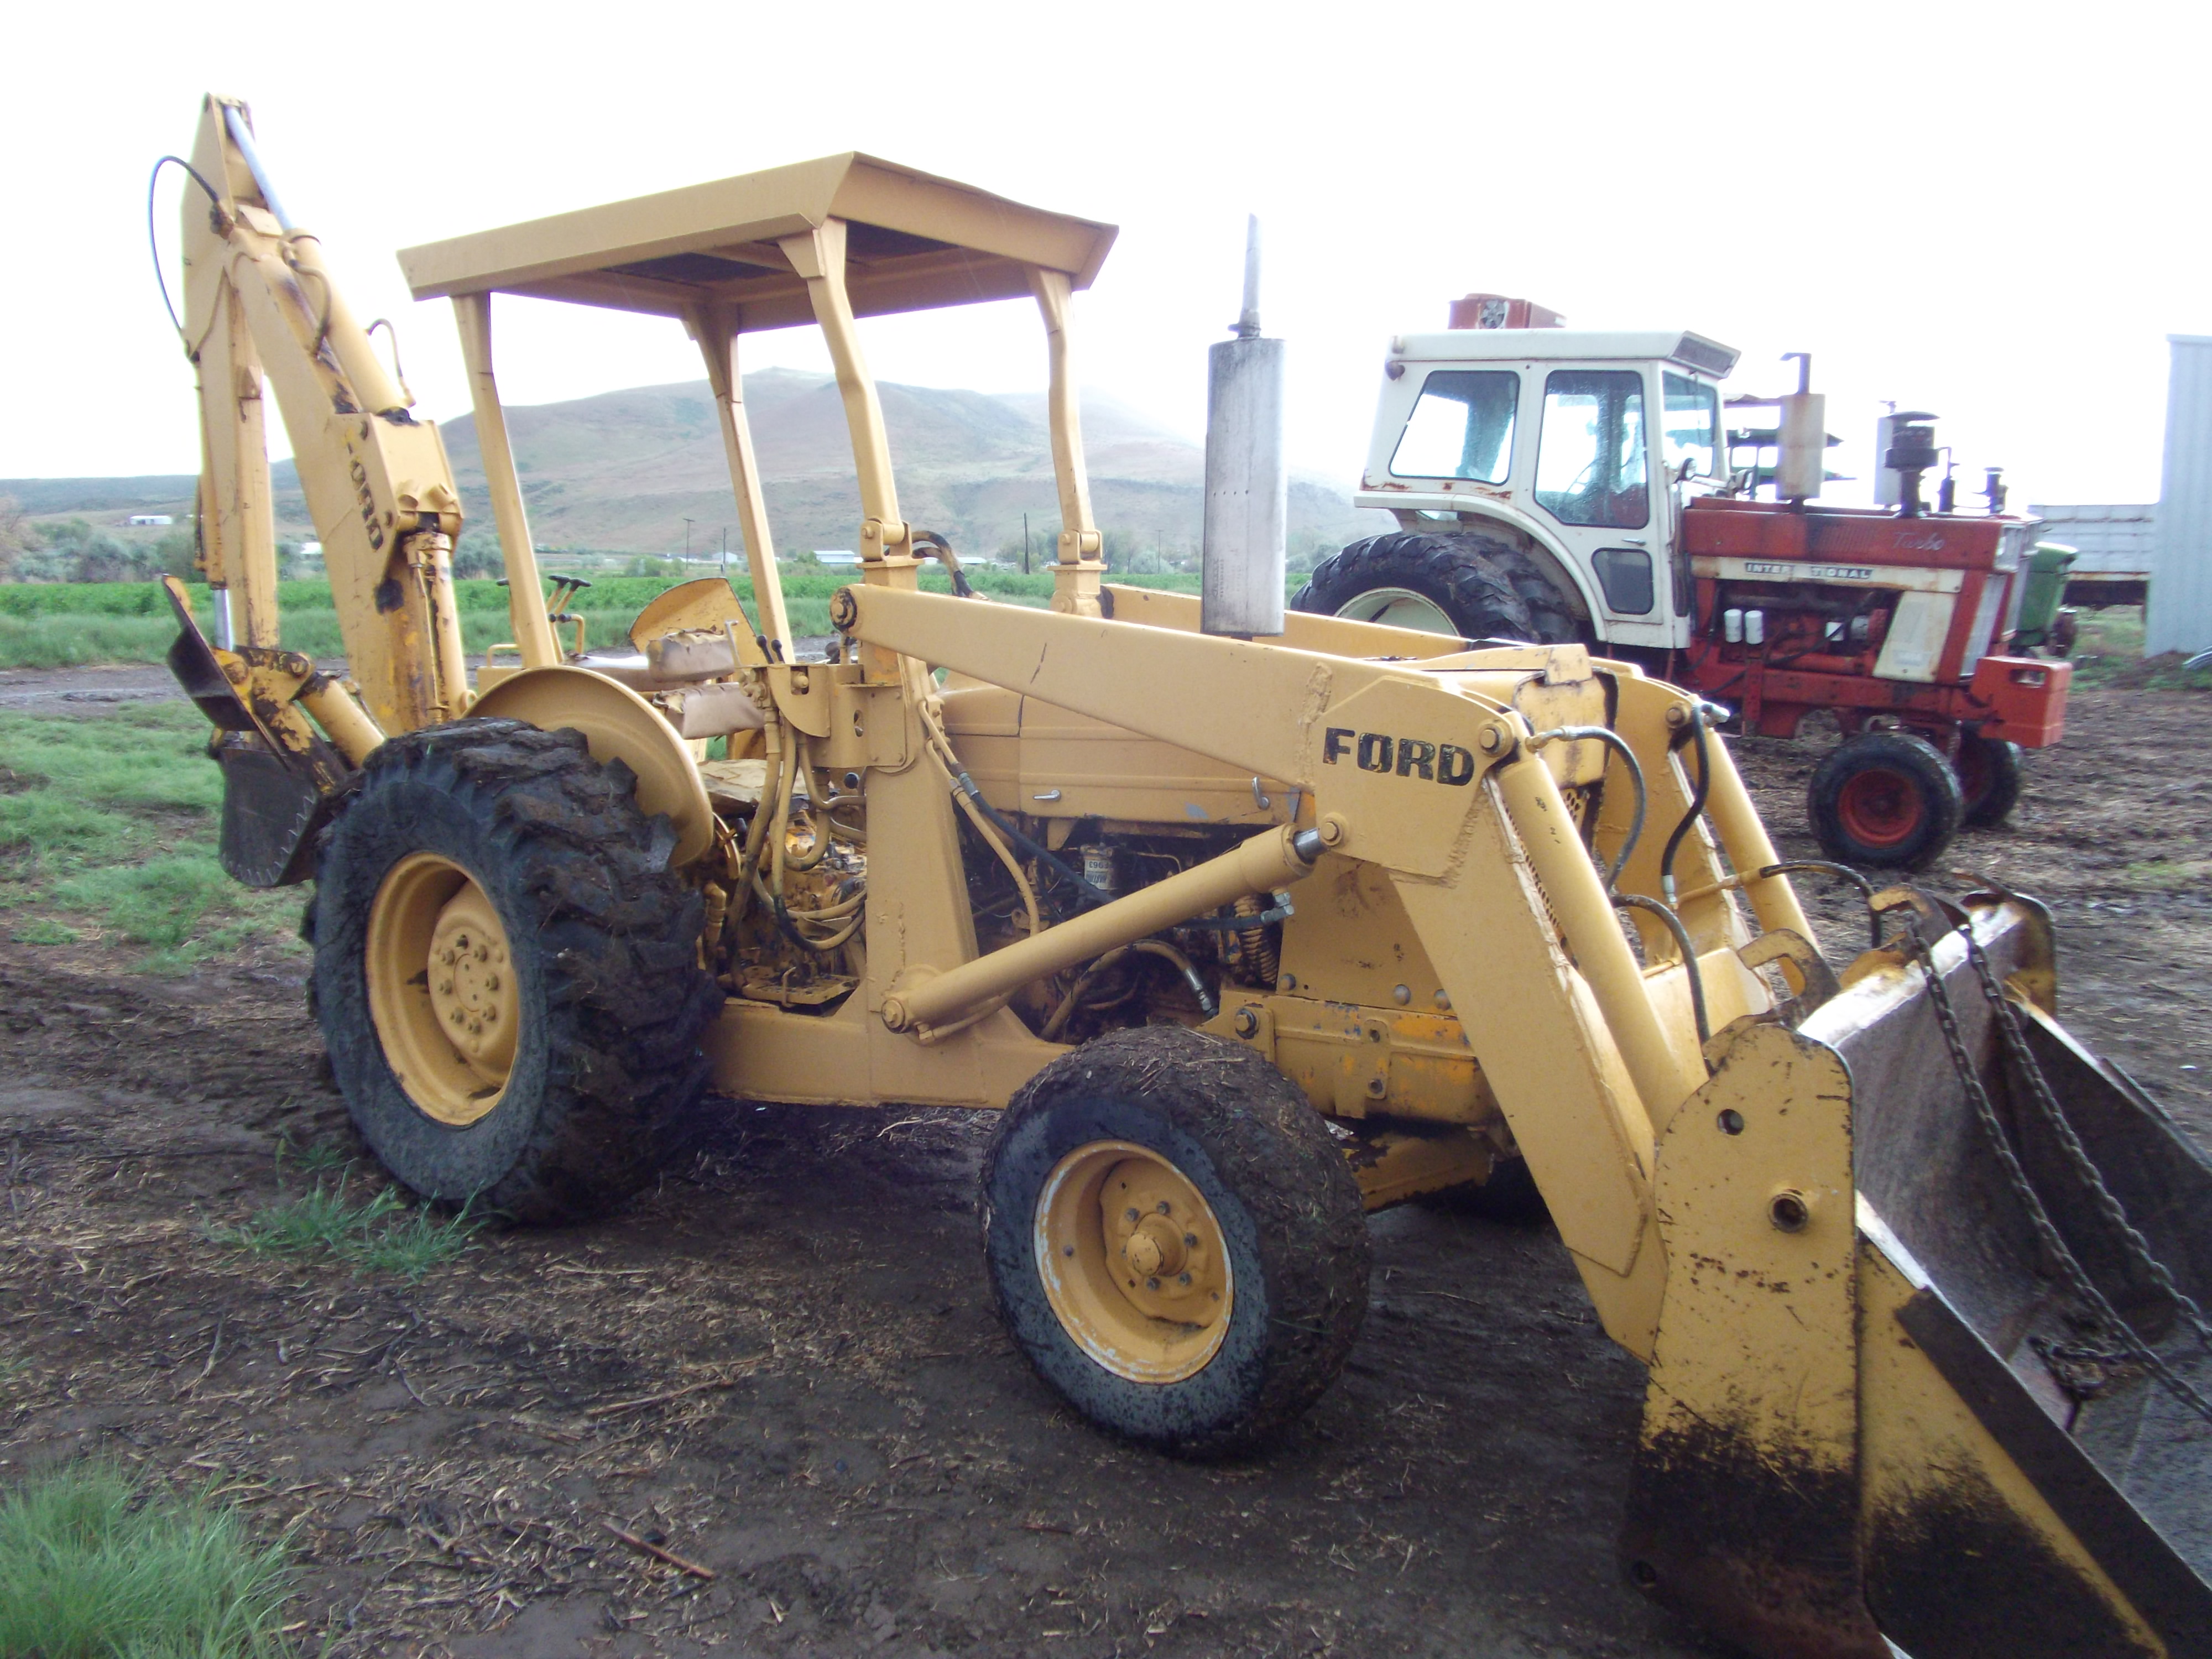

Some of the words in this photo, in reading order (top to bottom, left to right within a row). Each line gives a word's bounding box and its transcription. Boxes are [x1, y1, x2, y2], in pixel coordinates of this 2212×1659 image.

[345, 435, 383, 551] ORD
[1746, 564, 1871, 579] INTERTIONAL
[1323, 727, 1474, 786] FORD
